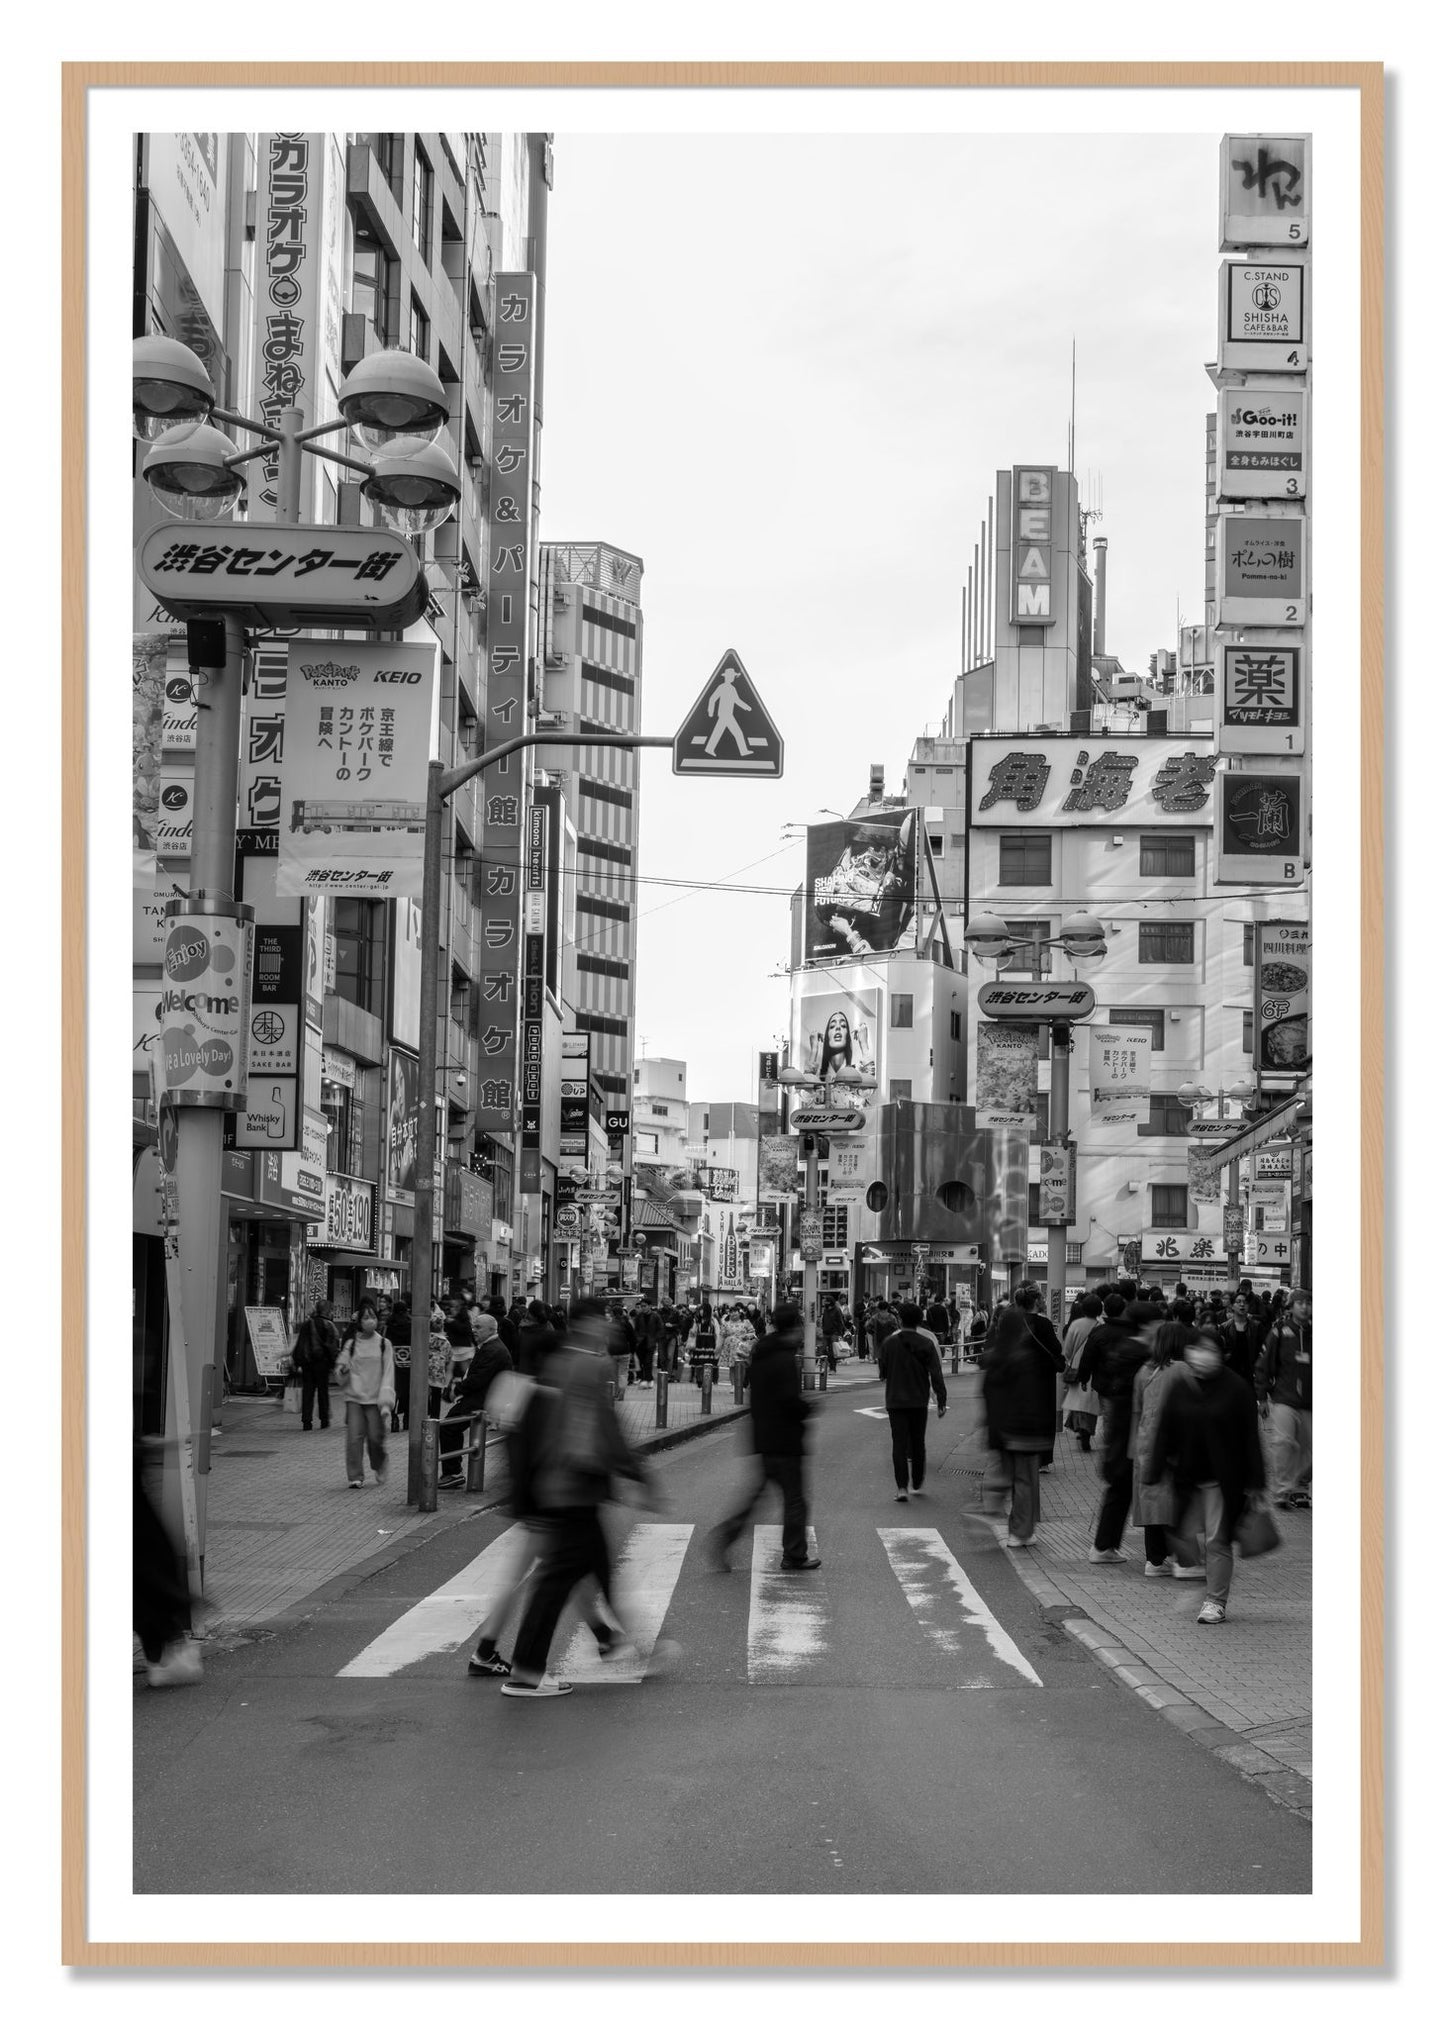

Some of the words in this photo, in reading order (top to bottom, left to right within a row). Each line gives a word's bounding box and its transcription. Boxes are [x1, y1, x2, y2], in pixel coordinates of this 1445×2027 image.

[268, 138, 308, 277] カラオケ
[1288, 224, 1301, 239] 5
[1244, 271, 1289, 281] C.STAND
[1244, 312, 1288, 323] SHISHA
[1287, 351, 1299, 366] 4
[1242, 410, 1297, 427] Goo-it!
[1235, 430, 1294, 439] 渋谷宇田川町店
[1230, 455, 1298, 467] 全身もみほぐし
[1286, 478, 1298, 494] 3
[1018, 472, 1051, 616] BEAM
[153, 543, 403, 581] 渋谷センター街
[1231, 549, 1296, 568] ポムの樹
[1285, 606, 1297, 621] 2
[313, 679, 348, 687] KANTO
[373, 671, 422, 684] KEIO
[1234, 654, 1285, 705] 薬
[1229, 708, 1291, 723] マツモトキヨシ
[317, 706, 334, 749] 冒険へ
[167, 734, 191, 743] 渋谷店
[336, 706, 354, 780] カントーの
[378, 707, 395, 767] 京王線で
[1285, 734, 1293, 749] 1
[979, 752, 1219, 811] 角海老
[1229, 790, 1289, 838] 一蘭
[531, 810, 542, 846] kimono
[162, 842, 188, 851] 渋谷店
[305, 869, 394, 883] 渋谷センター街
[1284, 862, 1296, 879] B
[263, 937, 278, 945] THE
[167, 938, 207, 974] Enjoy
[259, 945, 281, 953] THIRD
[259, 973, 280, 981] ROOM
[262, 984, 277, 992] BAR
[161, 989, 239, 1015] Welcome
[985, 991, 1089, 1004] 渋谷センター街
[1262, 1000, 1290, 1020] 6F
[180, 1047, 209, 1067] Lovely
[211, 1048, 231, 1061] Day!
[246, 1113, 280, 1125] Whisky
[608, 1117, 628, 1128] GU
[246, 1123, 267, 1131] Bank
[726, 1235, 736, 1278] BEER
